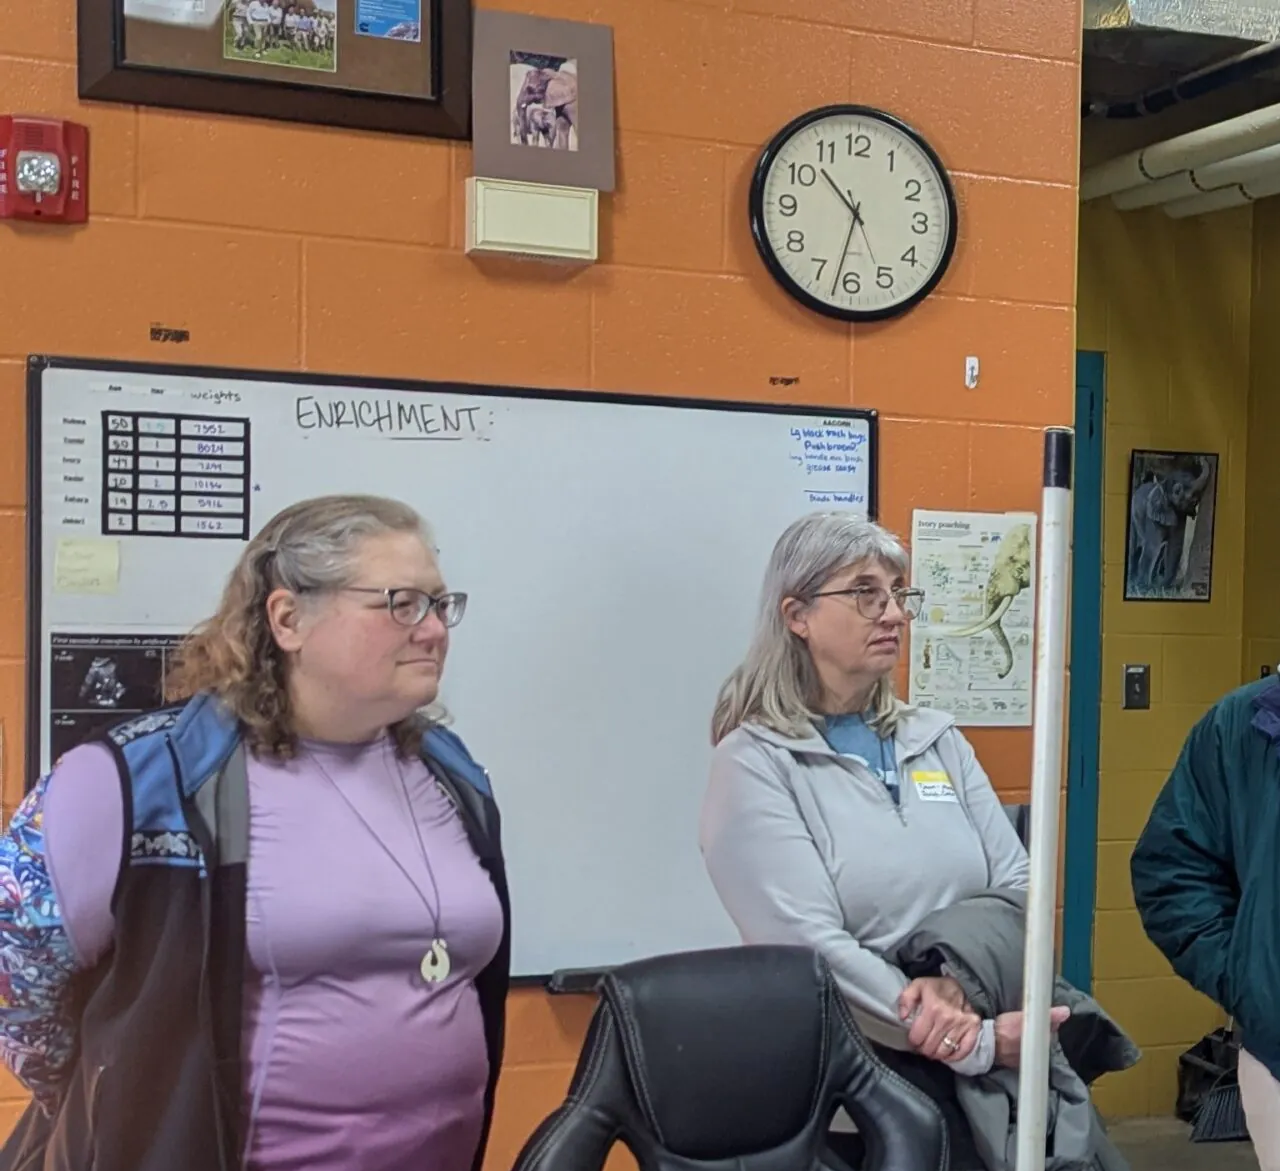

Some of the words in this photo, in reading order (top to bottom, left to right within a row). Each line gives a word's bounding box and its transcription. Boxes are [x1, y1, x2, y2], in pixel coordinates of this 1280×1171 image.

[817, 139, 836, 164] 11
[845, 133, 871, 158] 12
[887, 150, 895, 173] 1
[71, 156, 80, 201] FIRE
[788, 162, 817, 187] 10
[904, 179, 922, 202] 2
[779, 194, 797, 217] 9
[911, 212, 929, 235] 3
[786, 230, 805, 253] 8
[901, 245, 918, 268] 4
[811, 258, 828, 281] 7
[876, 266, 894, 289] 5
[842, 272, 861, 294] 6
[190, 389, 241, 404] weights
[111, 418, 129, 430] 50
[112, 440, 129, 449] 50
[918, 520, 936, 528] Ivory
